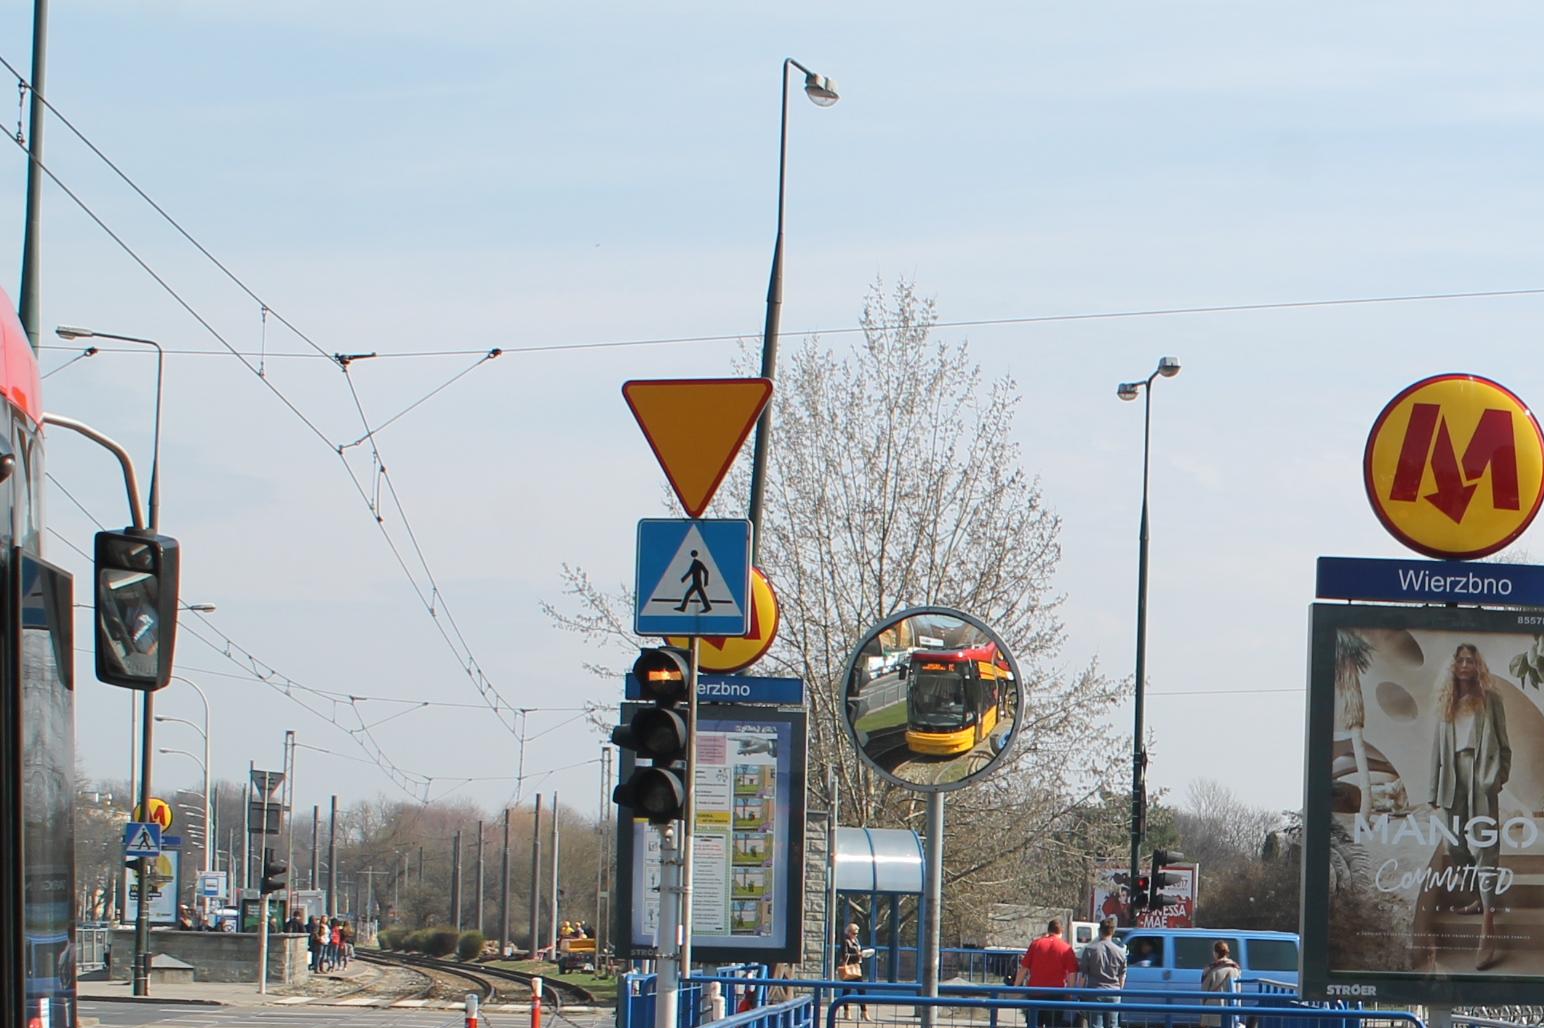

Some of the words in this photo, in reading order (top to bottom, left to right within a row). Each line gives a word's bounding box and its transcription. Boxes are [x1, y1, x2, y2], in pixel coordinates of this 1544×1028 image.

[1398, 568, 1513, 596] Wierzbno
[697, 681, 751, 697] erzbno
[1353, 813, 1539, 849] MANGO
